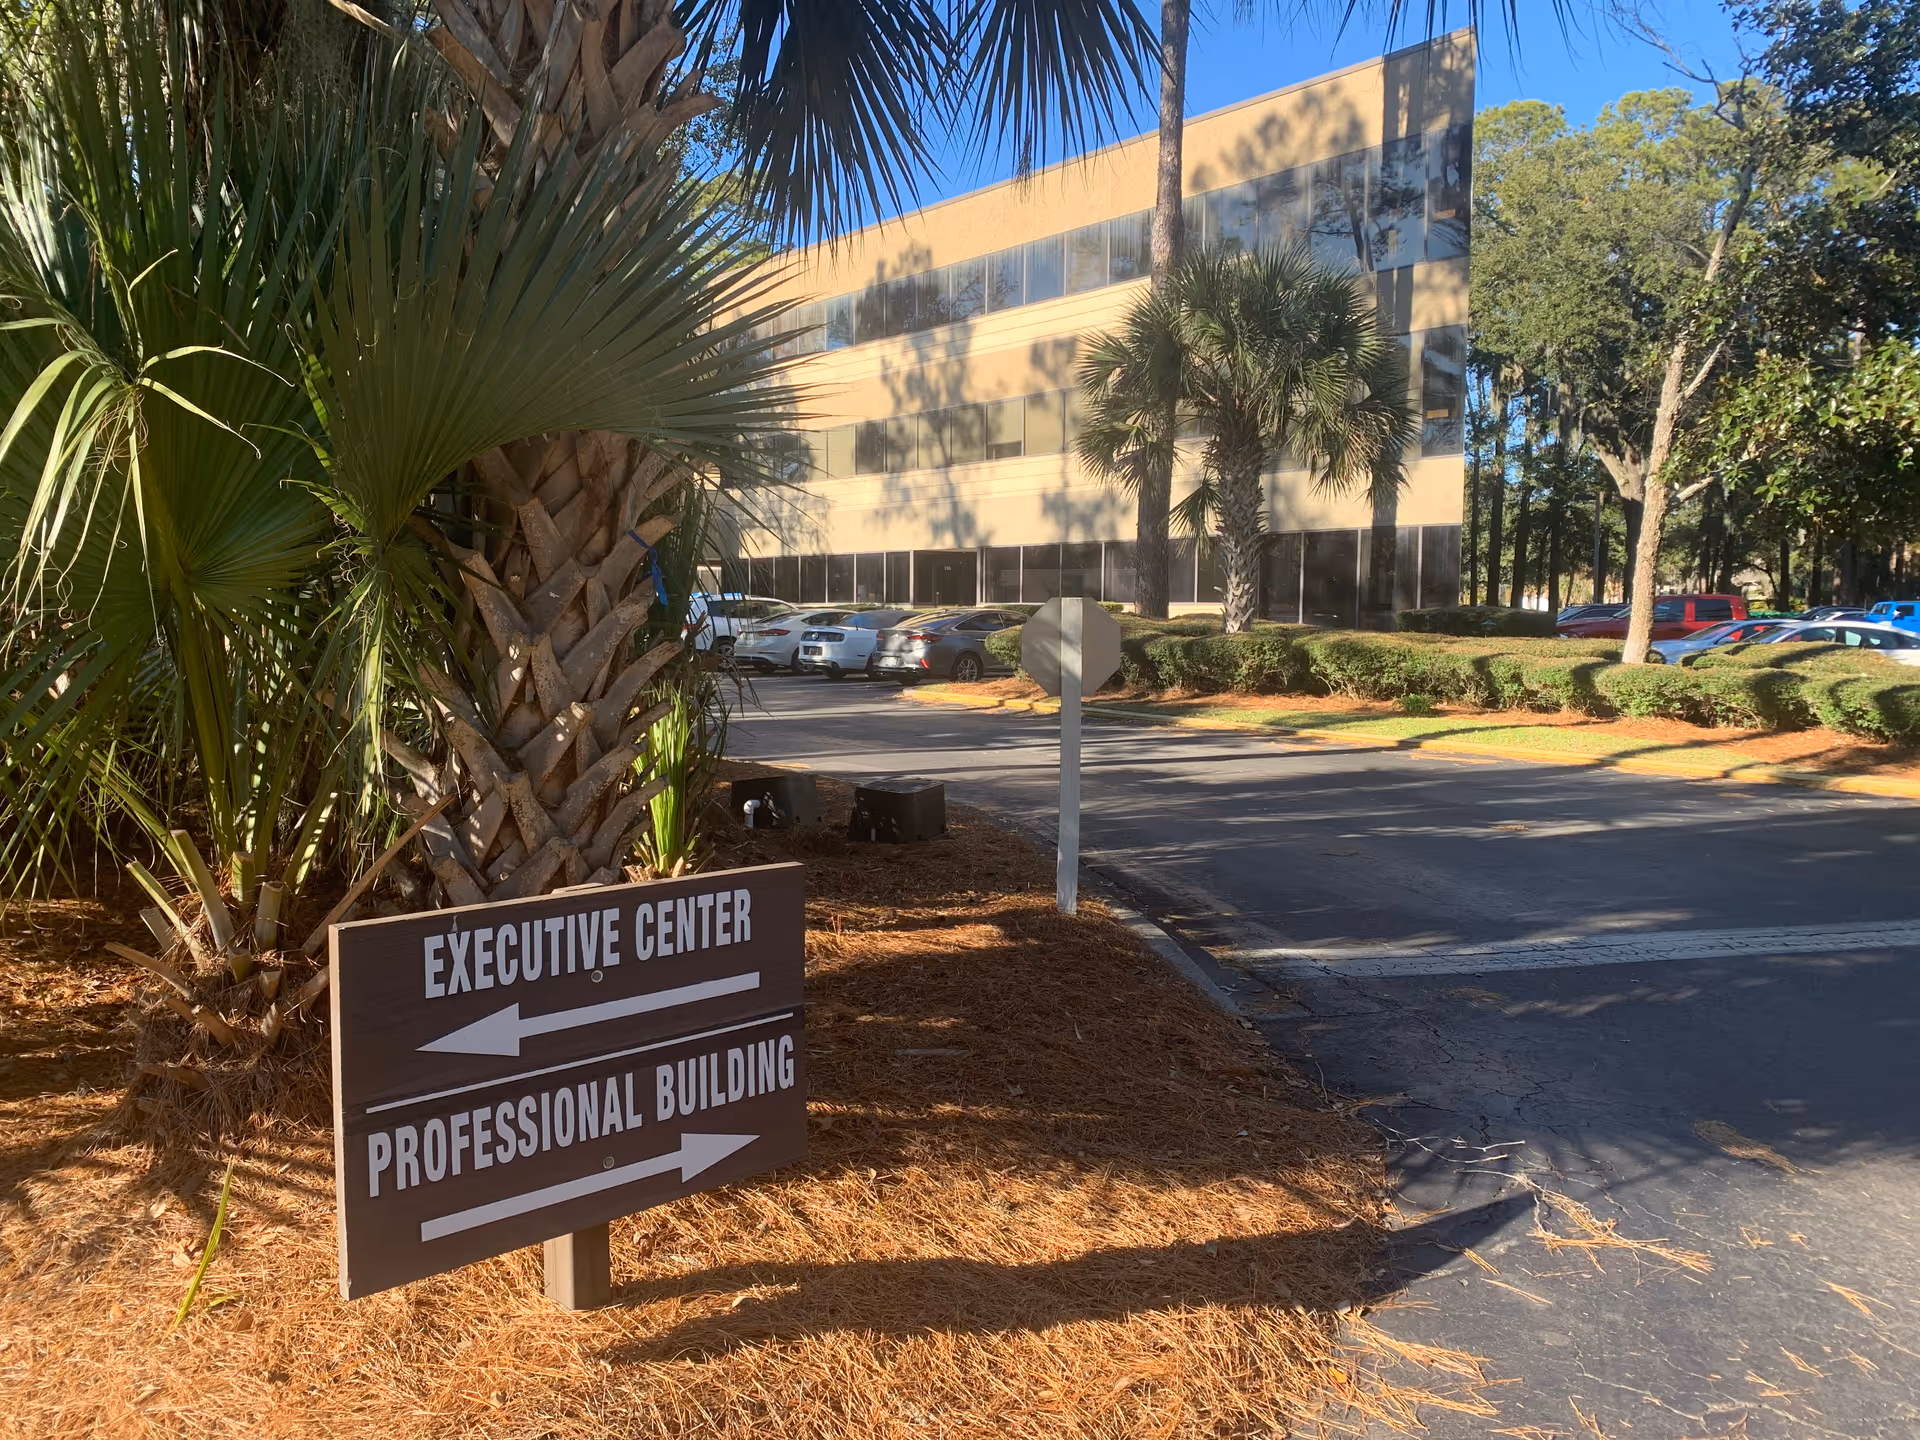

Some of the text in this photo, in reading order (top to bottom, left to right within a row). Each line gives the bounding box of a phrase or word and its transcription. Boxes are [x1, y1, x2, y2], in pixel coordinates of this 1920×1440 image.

[423, 888, 752, 999] EXECUTIVE CENTER
[367, 1034, 795, 1197] PROFESSIONAL BUILDING
